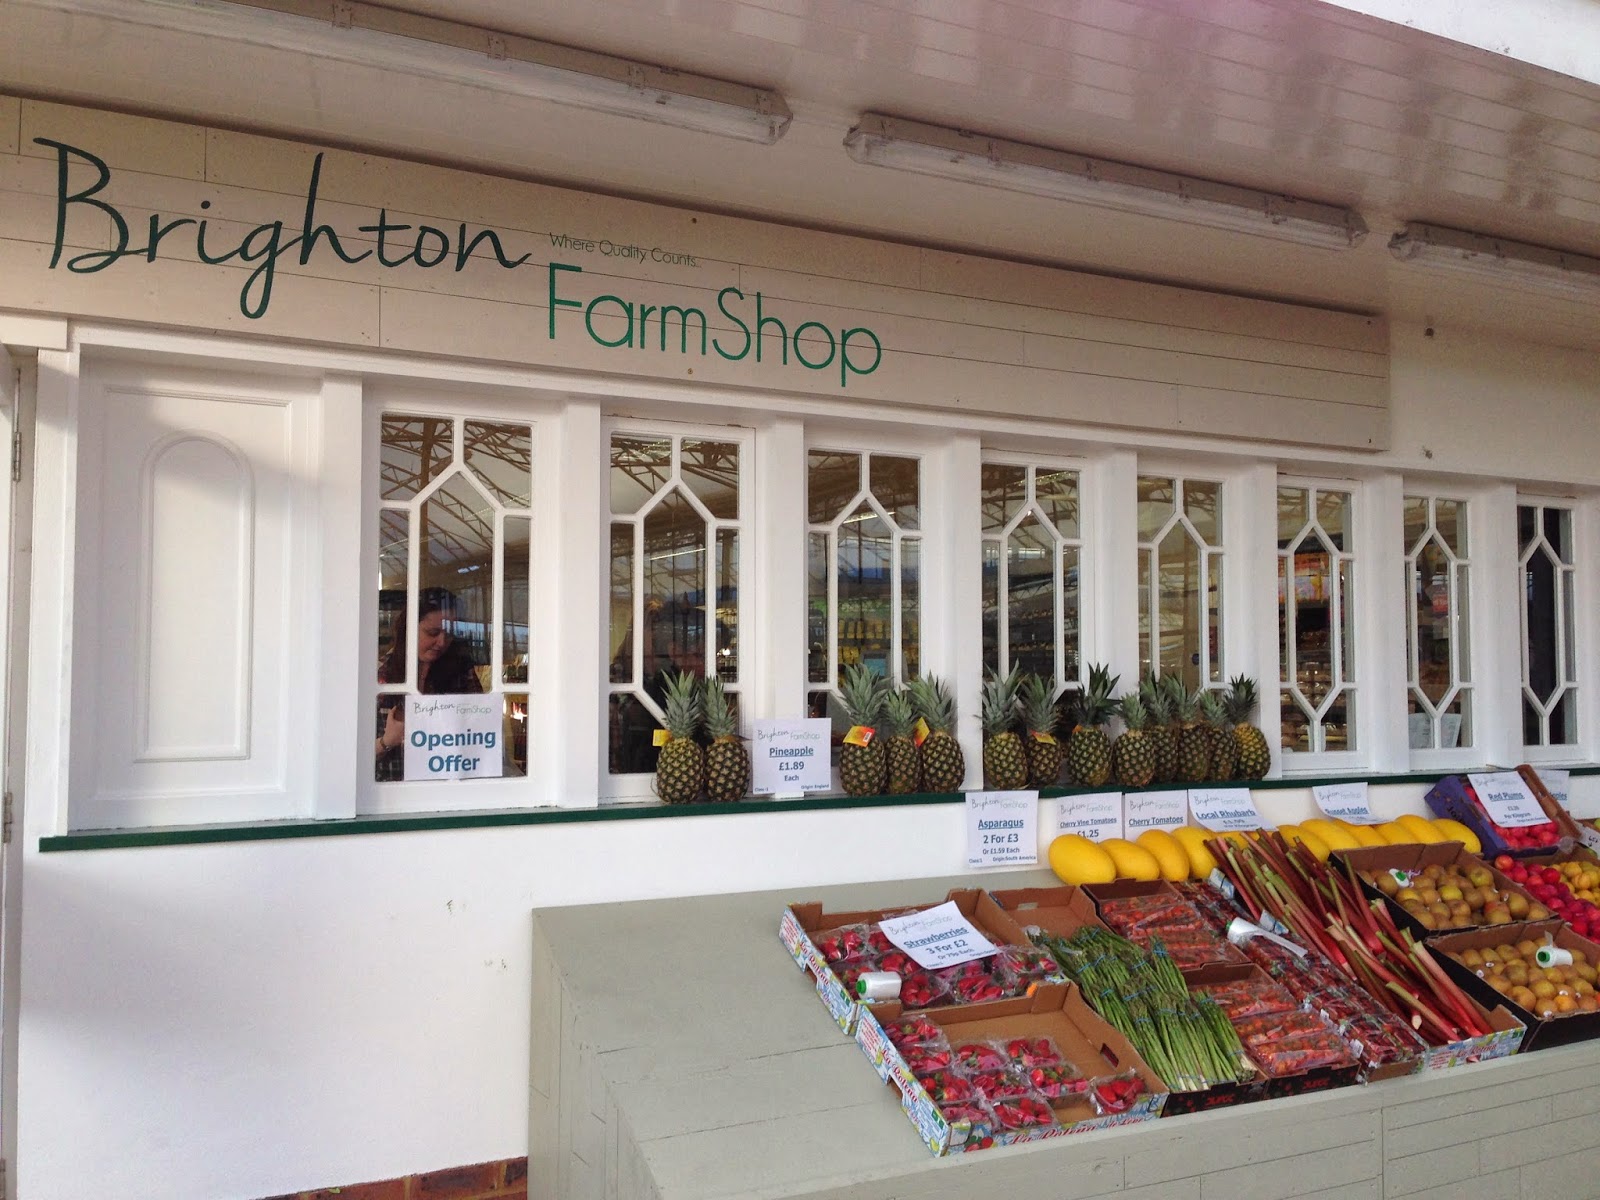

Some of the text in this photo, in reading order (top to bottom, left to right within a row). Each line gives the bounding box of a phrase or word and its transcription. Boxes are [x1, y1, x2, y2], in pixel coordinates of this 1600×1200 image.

[34, 137, 532, 319] Brighton
[549, 232, 595, 253] Where
[599, 239, 648, 265] Quality
[549, 261, 882, 388] FarmShop
[413, 699, 492, 717] Brighton FarmShop
[410, 728, 497, 751] Opening
[757, 727, 790, 743] Brighton
[768, 745, 814, 758] Pineapple
[427, 754, 481, 773] Offer
[778, 761, 805, 771] £1.89
[784, 774, 800, 782] Each
[971, 795, 1000, 811] Brighton
[1487, 791, 1526, 802] Red Plums
[1060, 801, 1086, 815] Brighton
[1129, 798, 1155, 811] Brighton
[1128, 814, 1184, 828] Cherry Tomatoes
[1195, 808, 1257, 820] Local Rhubarb
[978, 818, 1024, 831] Asparagus
[1059, 820, 1076, 829] Cherry
[1091, 816, 1118, 825] Tomatoes
[983, 833, 1019, 844] 2 For £3
[990, 847, 1005, 855] £1.59
[903, 926, 970, 949] Strawberries
[925, 939, 969, 955] 3 For £2
